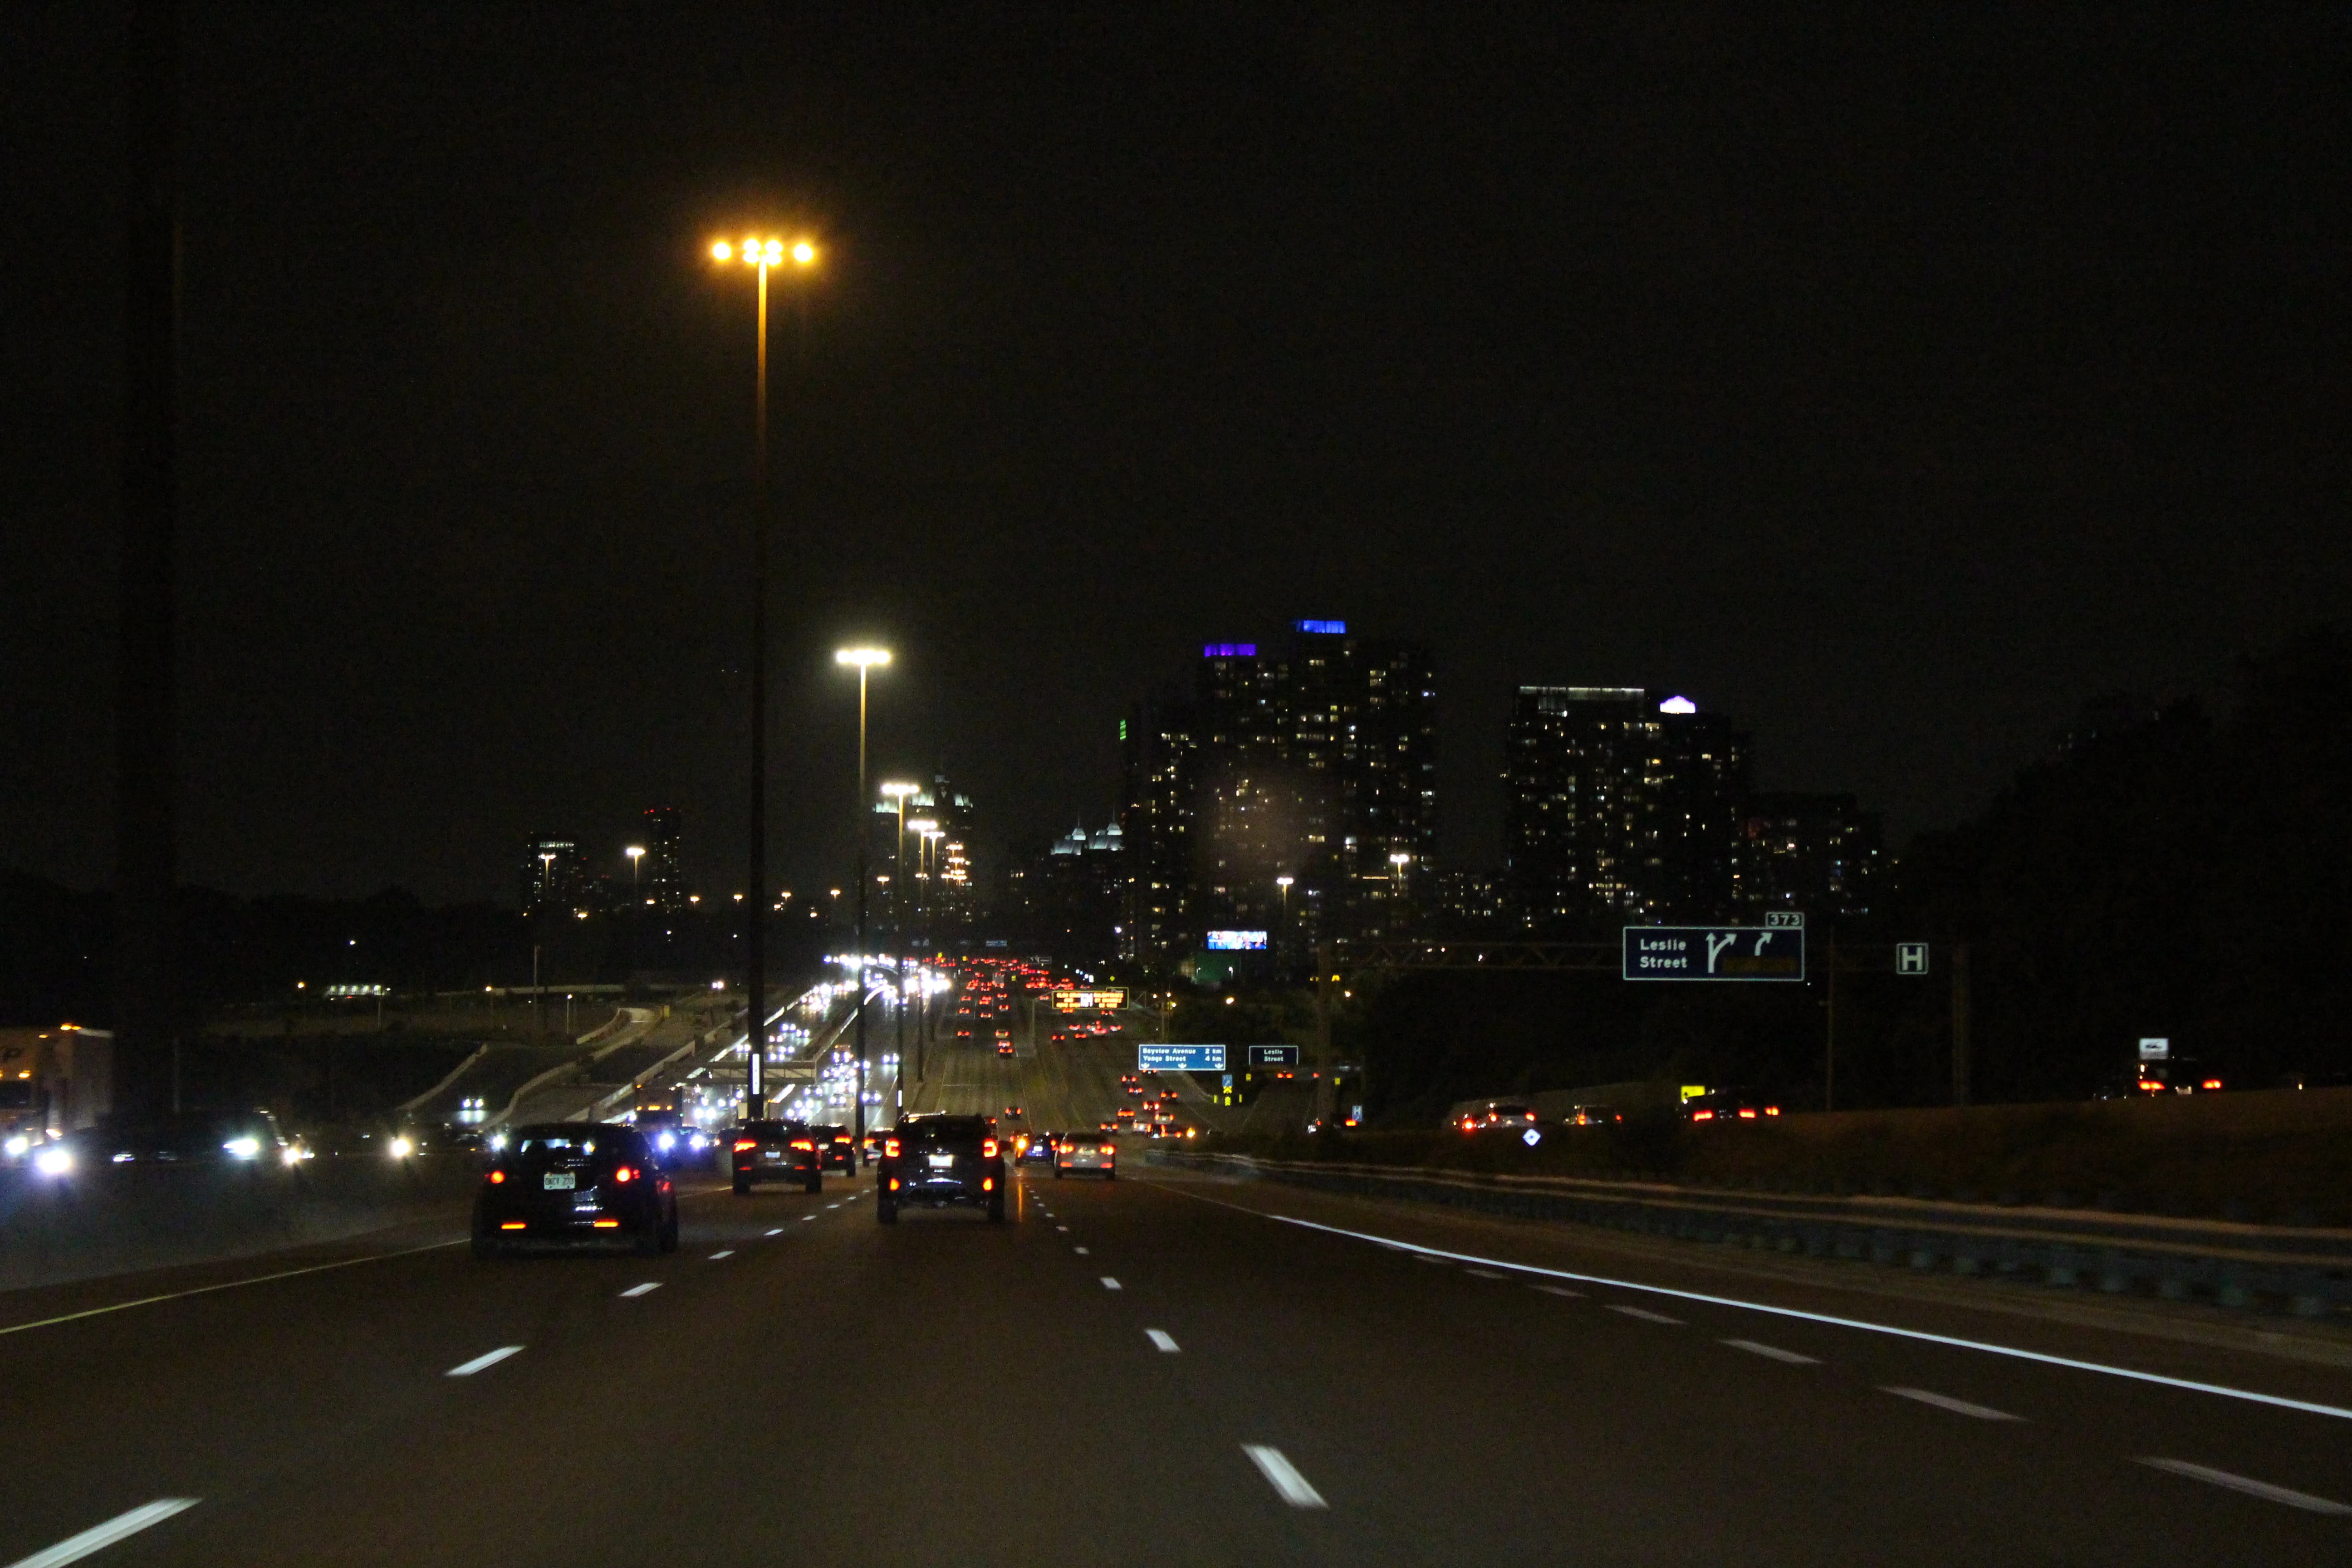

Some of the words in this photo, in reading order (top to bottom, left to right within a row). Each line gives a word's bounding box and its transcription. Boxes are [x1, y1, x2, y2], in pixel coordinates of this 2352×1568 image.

[1770, 915, 1800, 926] 373
[1640, 938, 1687, 951] Leslie
[1639, 956, 1688, 969] Street
[1901, 946, 1923, 971] H
